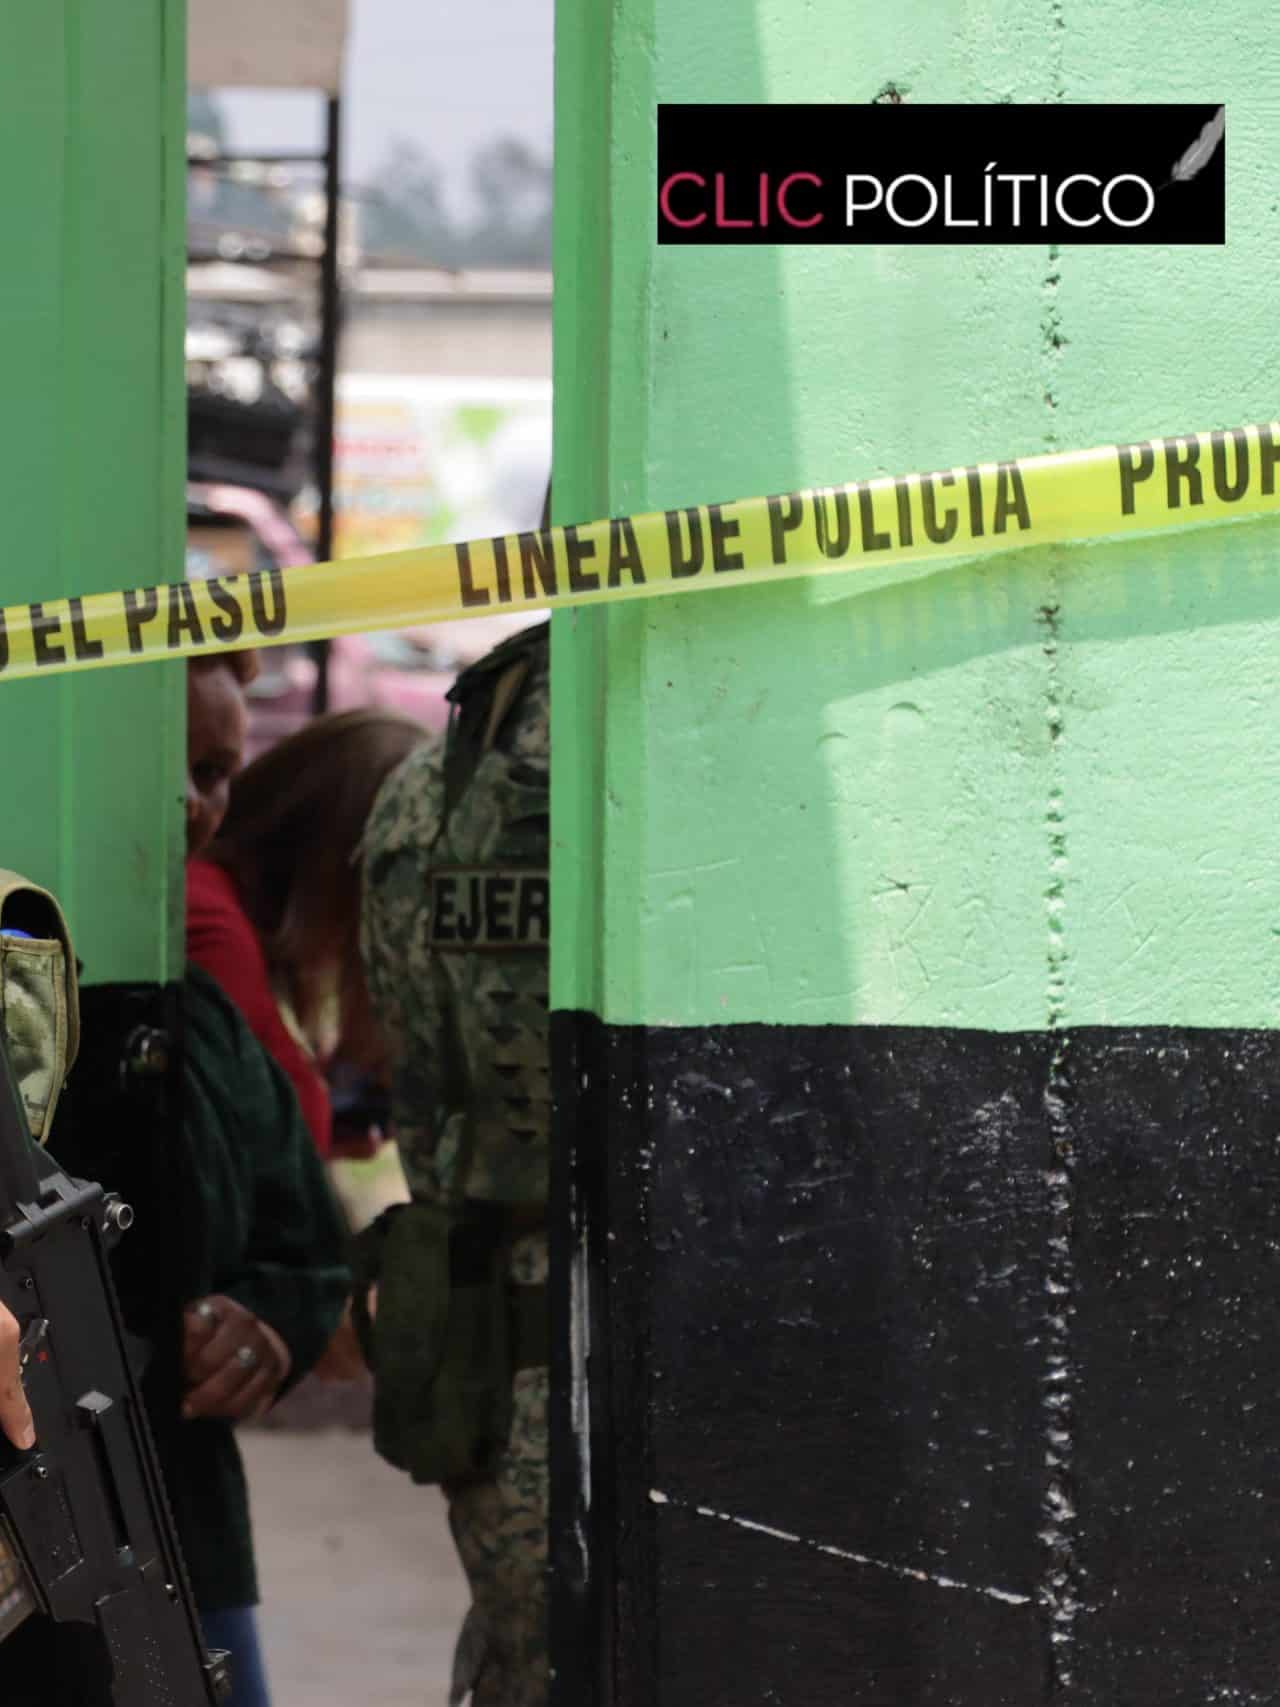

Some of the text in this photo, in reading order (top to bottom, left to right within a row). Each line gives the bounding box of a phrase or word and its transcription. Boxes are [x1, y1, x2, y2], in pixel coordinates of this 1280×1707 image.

[30, 597, 104, 667] EL
[122, 570, 288, 654] PASO
[455, 516, 646, 608] LINEA
[665, 503, 745, 579] DE
[767, 460, 1032, 565] POLICIA
[433, 876, 549, 943] EJER
